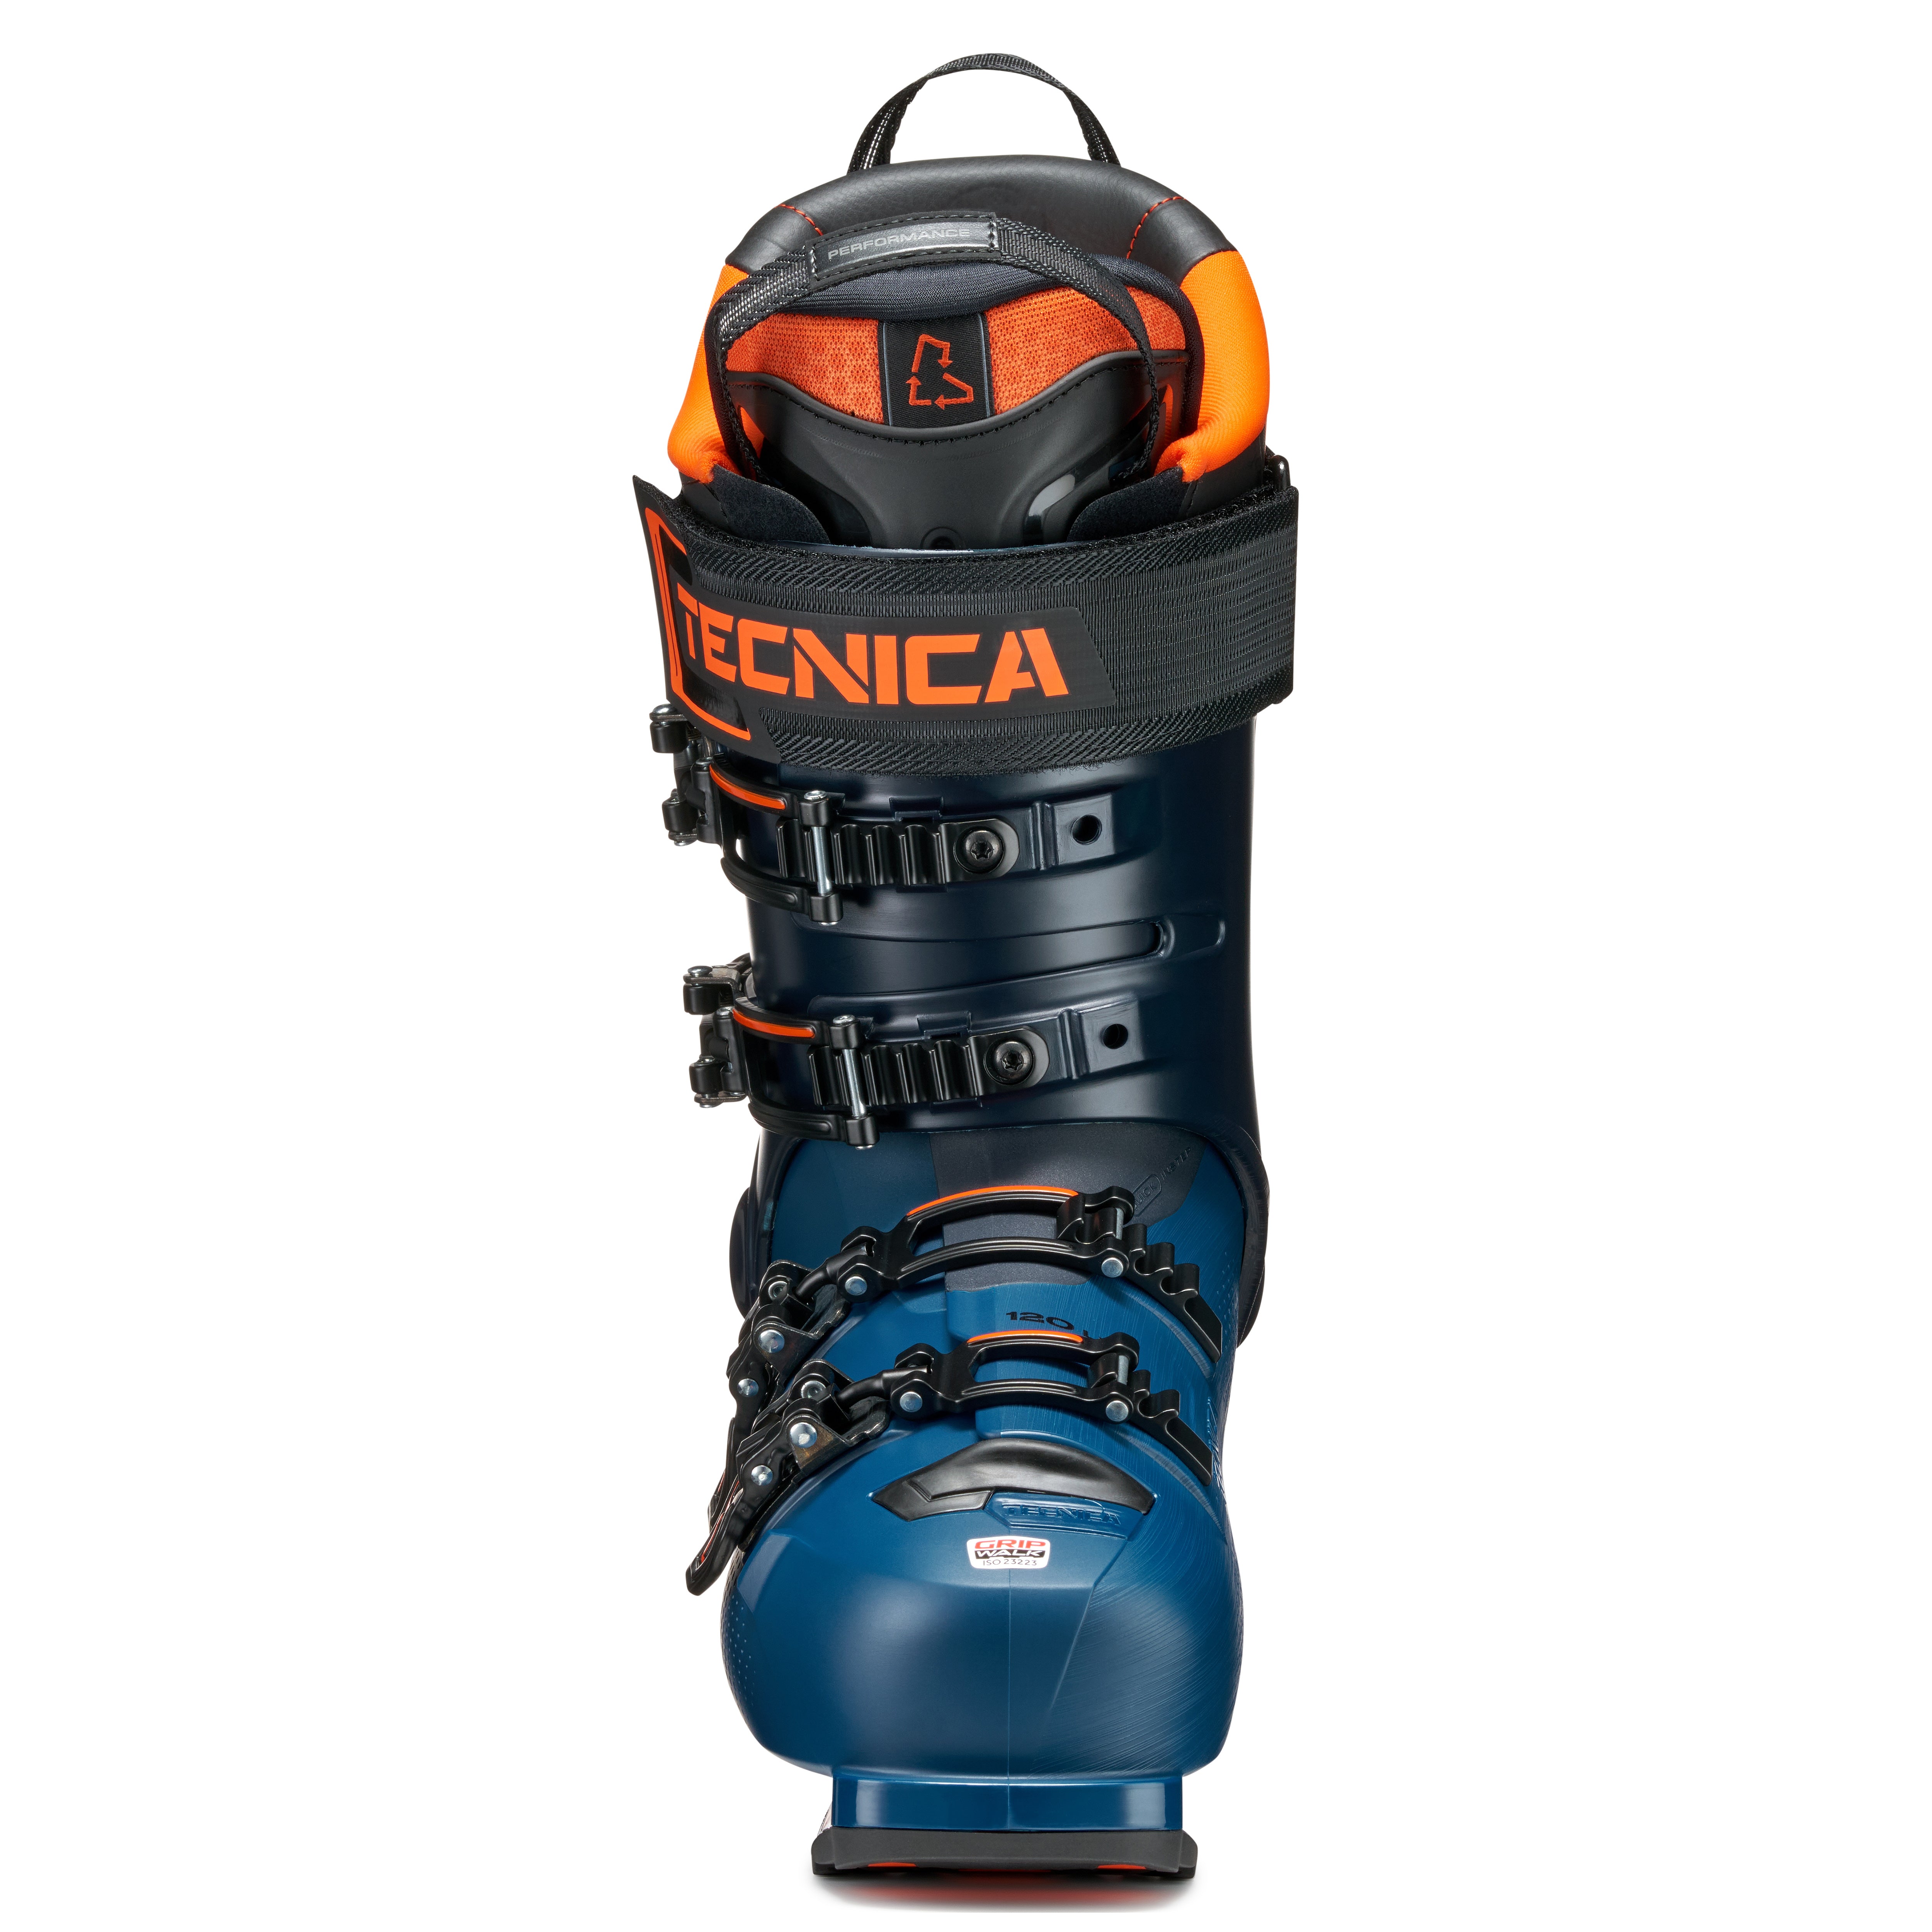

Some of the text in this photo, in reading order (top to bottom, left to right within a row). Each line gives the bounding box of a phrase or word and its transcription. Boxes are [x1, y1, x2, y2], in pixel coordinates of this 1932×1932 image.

[828, 229, 970, 260] PERFORMANCE
[677, 587, 1069, 706] TECNICA
[1160, 1148, 1191, 1180] INSTEP
[1006, 1311, 1074, 1330] 120
[1002, 1503, 1121, 1526] TECNICA
[975, 1539, 1046, 1549] GRIP
[976, 1549, 1043, 1557] WALK
